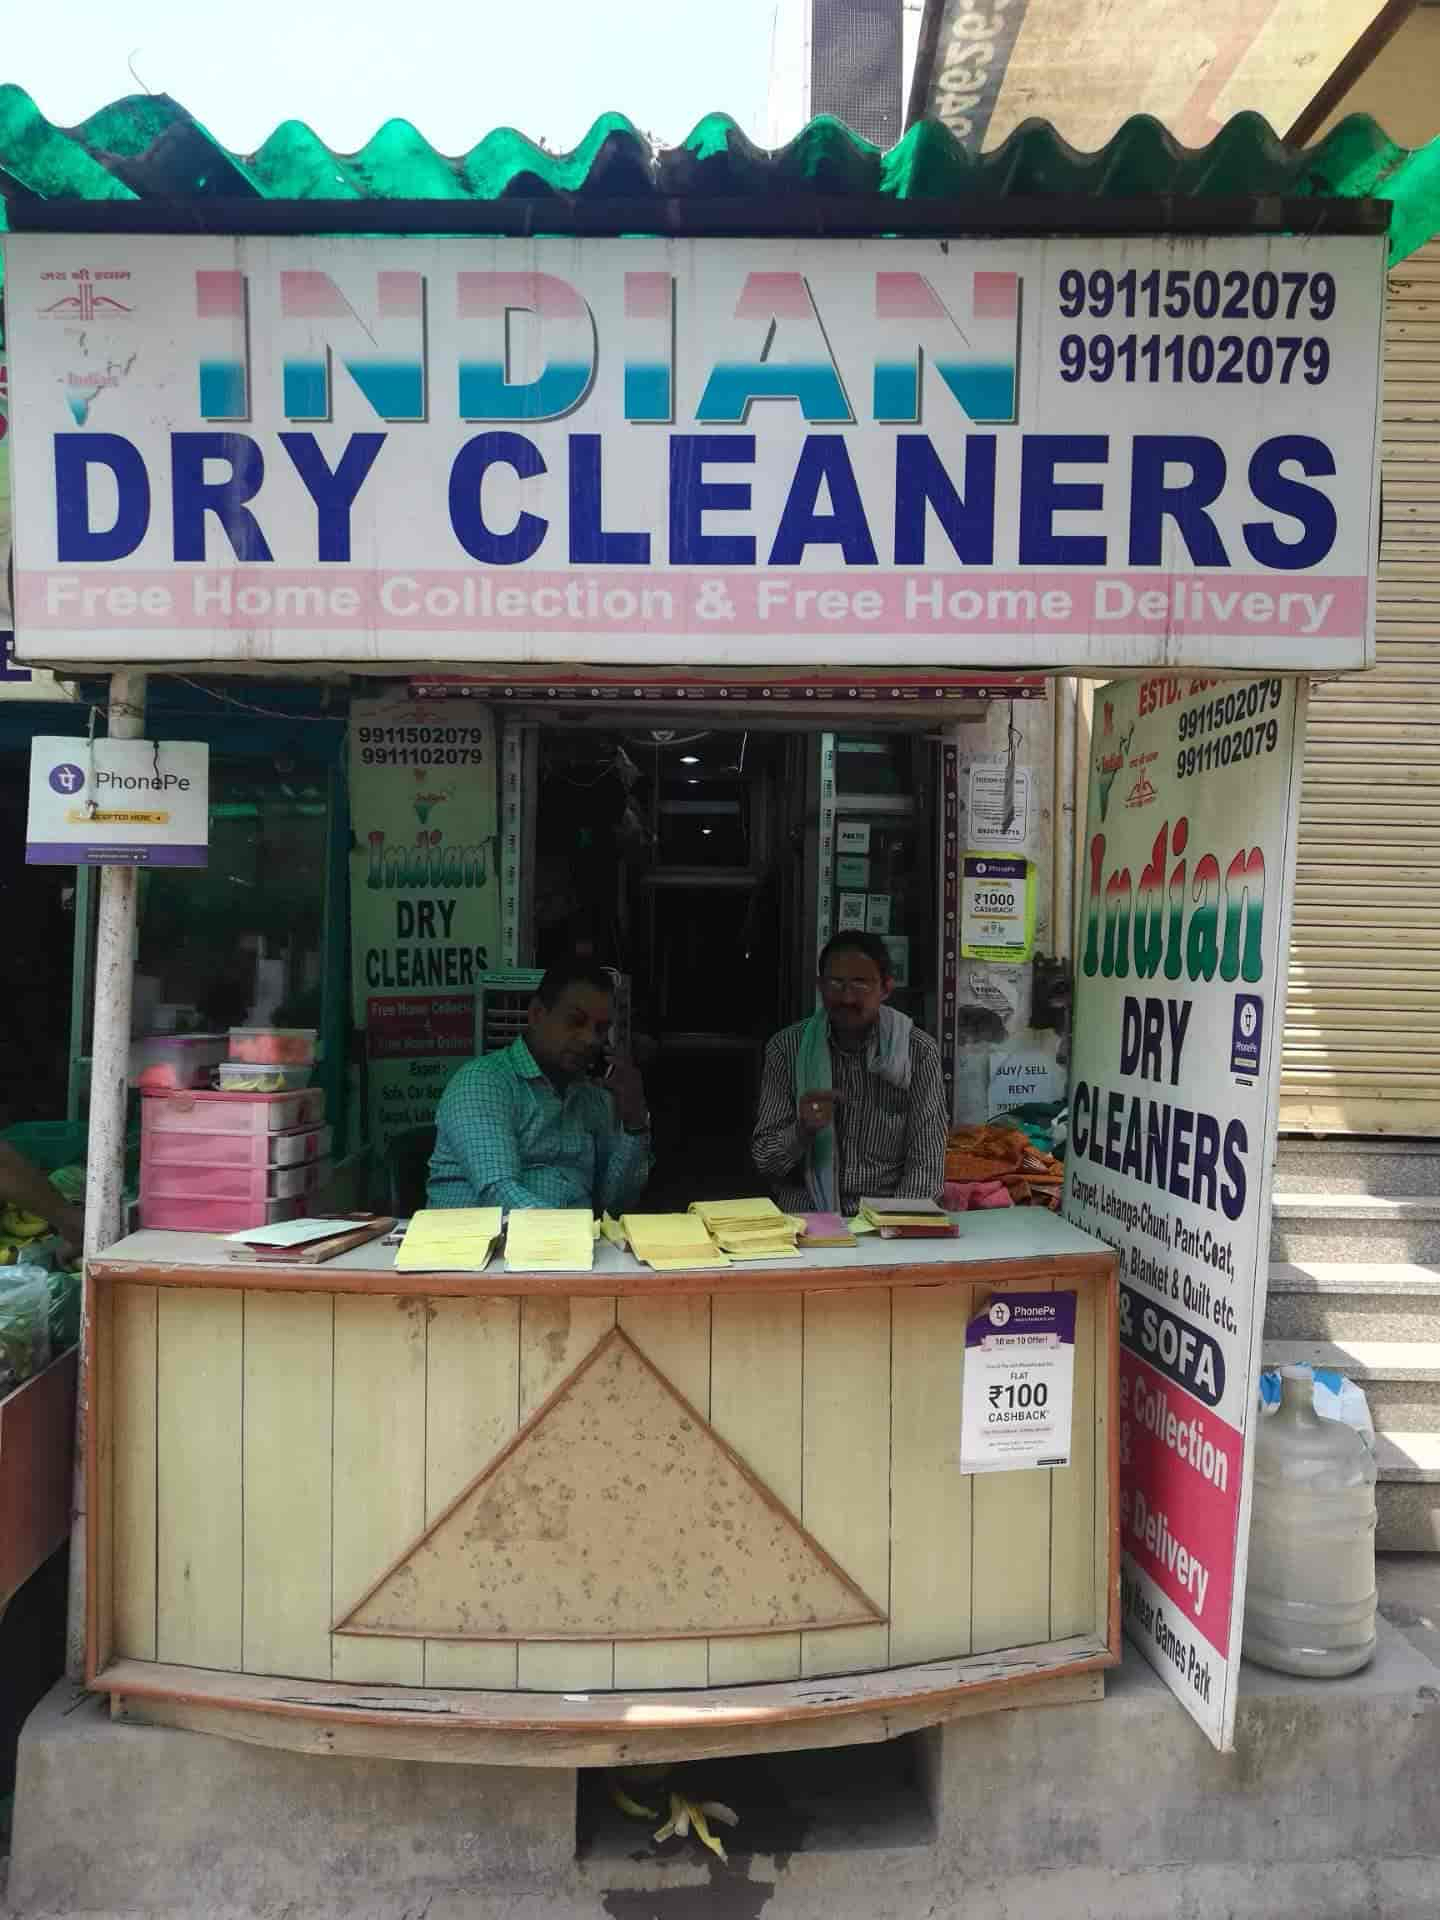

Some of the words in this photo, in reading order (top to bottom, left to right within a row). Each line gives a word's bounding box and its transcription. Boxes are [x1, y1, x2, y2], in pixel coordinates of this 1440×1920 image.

[1059, 269, 1337, 321] 9911502079
[195, 270, 1023, 425] INDIAN
[1059, 334, 1331, 386] 9911102079
[53, 431, 388, 563] DRY
[448, 431, 1338, 568] CLEANERS
[46, 575, 172, 617] Free
[193, 575, 361, 617] Home
[381, 575, 674, 620] Collection
[695, 577, 737, 620] &
[757, 579, 882, 621] Free
[905, 580, 1073, 622] Home
[1094, 579, 1335, 634] Delivery
[359, 727, 482, 744] 9911502079
[1179, 678, 1282, 742] 9911502079
[362, 748, 482, 765] 9911102079
[1177, 718, 1278, 779] 9911102079
[95, 772, 191, 792] PhonePe
[396, 899, 456, 939] DRY
[1083, 815, 1266, 984] Indian
[366, 946, 488, 988] CLEANERS
[1119, 996, 1192, 1086] DRY
[1072, 1080, 1249, 1222] CLEANERS
[1071, 1171, 1099, 1215] Carpet,
[1101, 1187, 1171, 1246] Lehanga-Chuni,
[1174, 1217, 1236, 1284] Pant-Coat,
[1014, 1305, 1056, 1316] PhonePe
[1131, 1247, 1169, 1297] Blanket
[1171, 1267, 1180, 1301] &
[1183, 1274, 1210, 1320] Quilt
[1213, 1296, 1238, 1336] etc.
[1010, 1371, 1029, 1381] FLAT
[1141, 1307, 1218, 1397] SOFA
[988, 1382, 1049, 1409] ₹100
[1134, 1374, 1229, 1494] Collection
[1134, 1488, 1209, 1617] Delivery
[1155, 1606, 1187, 1675] Games
[1188, 1642, 1211, 1705] Park
